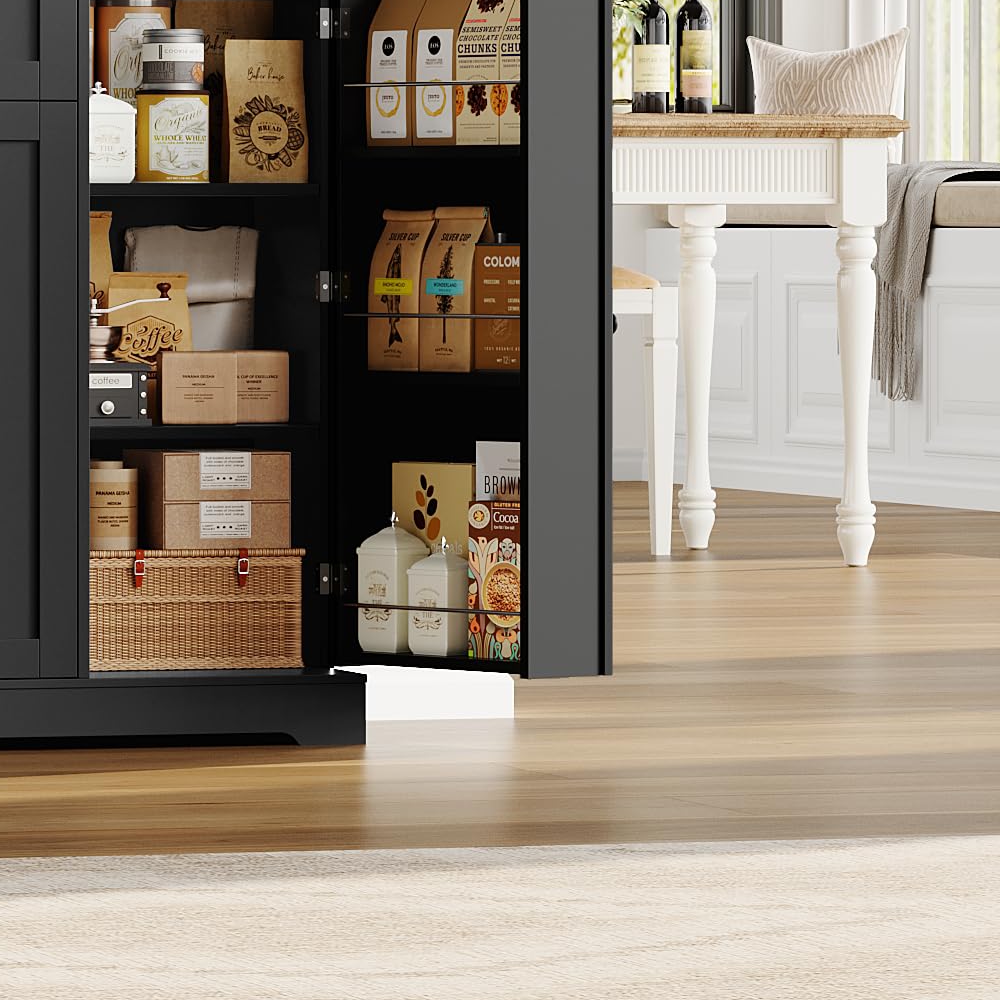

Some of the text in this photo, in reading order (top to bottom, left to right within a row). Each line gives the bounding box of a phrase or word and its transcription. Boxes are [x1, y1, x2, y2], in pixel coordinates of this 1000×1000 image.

[461, 25, 503, 33] SEMISWEET
[458, 34, 500, 42] CHOCOLATE
[457, 43, 497, 54] CHUNKS
[257, 125, 282, 133] BREAD
[388, 232, 420, 241] SILVER CUP
[440, 232, 472, 242] SILVER CUP
[483, 255, 520, 268] COLOM
[91, 376, 120, 385] coffee
[493, 511, 519, 524] Cocoa
